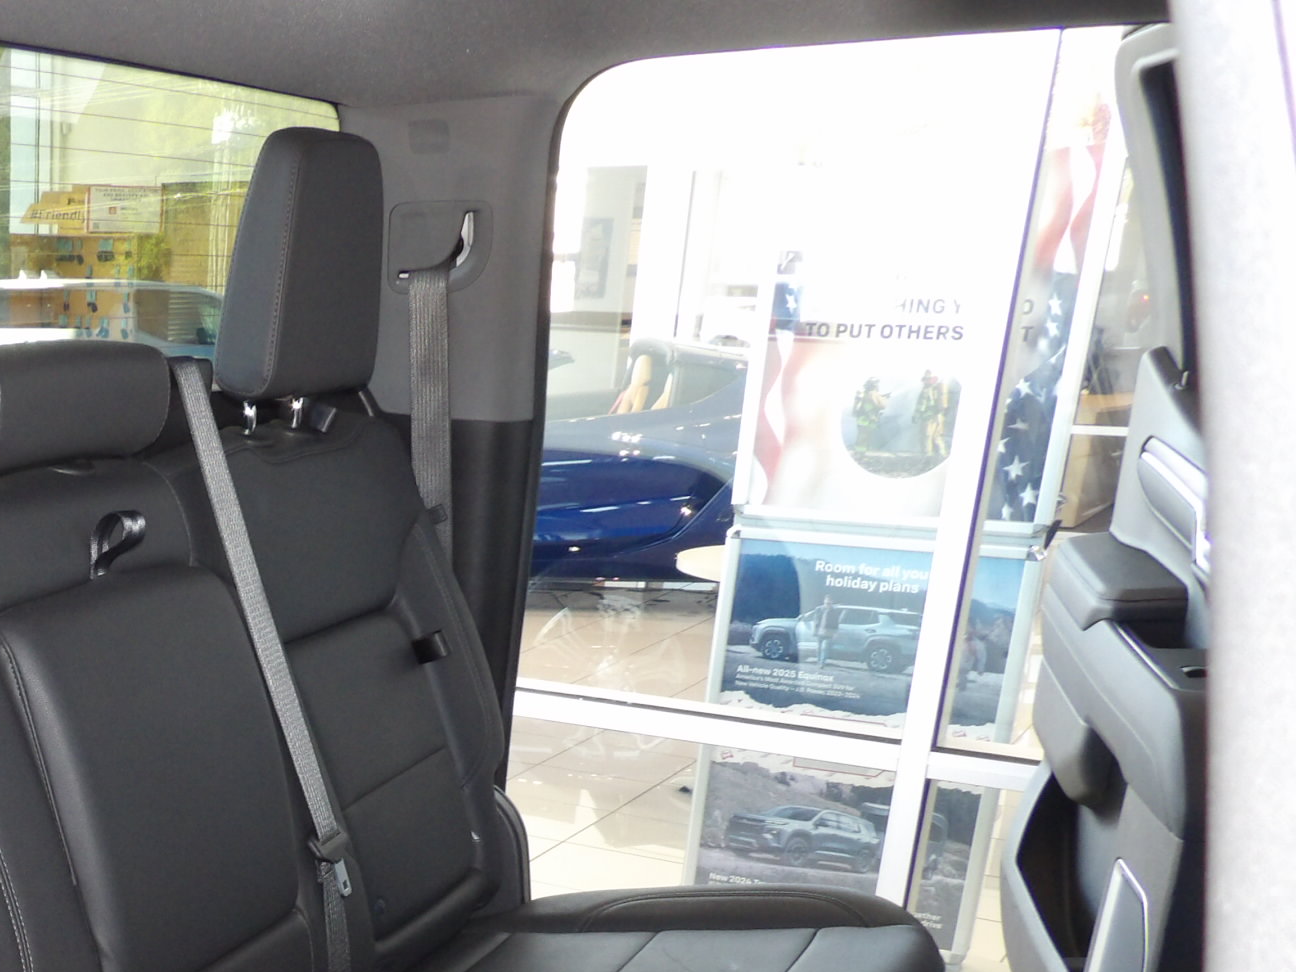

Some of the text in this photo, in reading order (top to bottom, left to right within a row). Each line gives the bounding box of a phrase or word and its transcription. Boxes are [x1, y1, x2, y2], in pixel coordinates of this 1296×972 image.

[805, 322, 830, 338] TO
[835, 323, 876, 339] PUT
[880, 323, 965, 341] OTHERS
[815, 560, 929, 581] Room for all you
[825, 575, 920, 594] holiday plans
[736, 664, 771, 676] All-new
[772, 668, 796, 679] 2025
